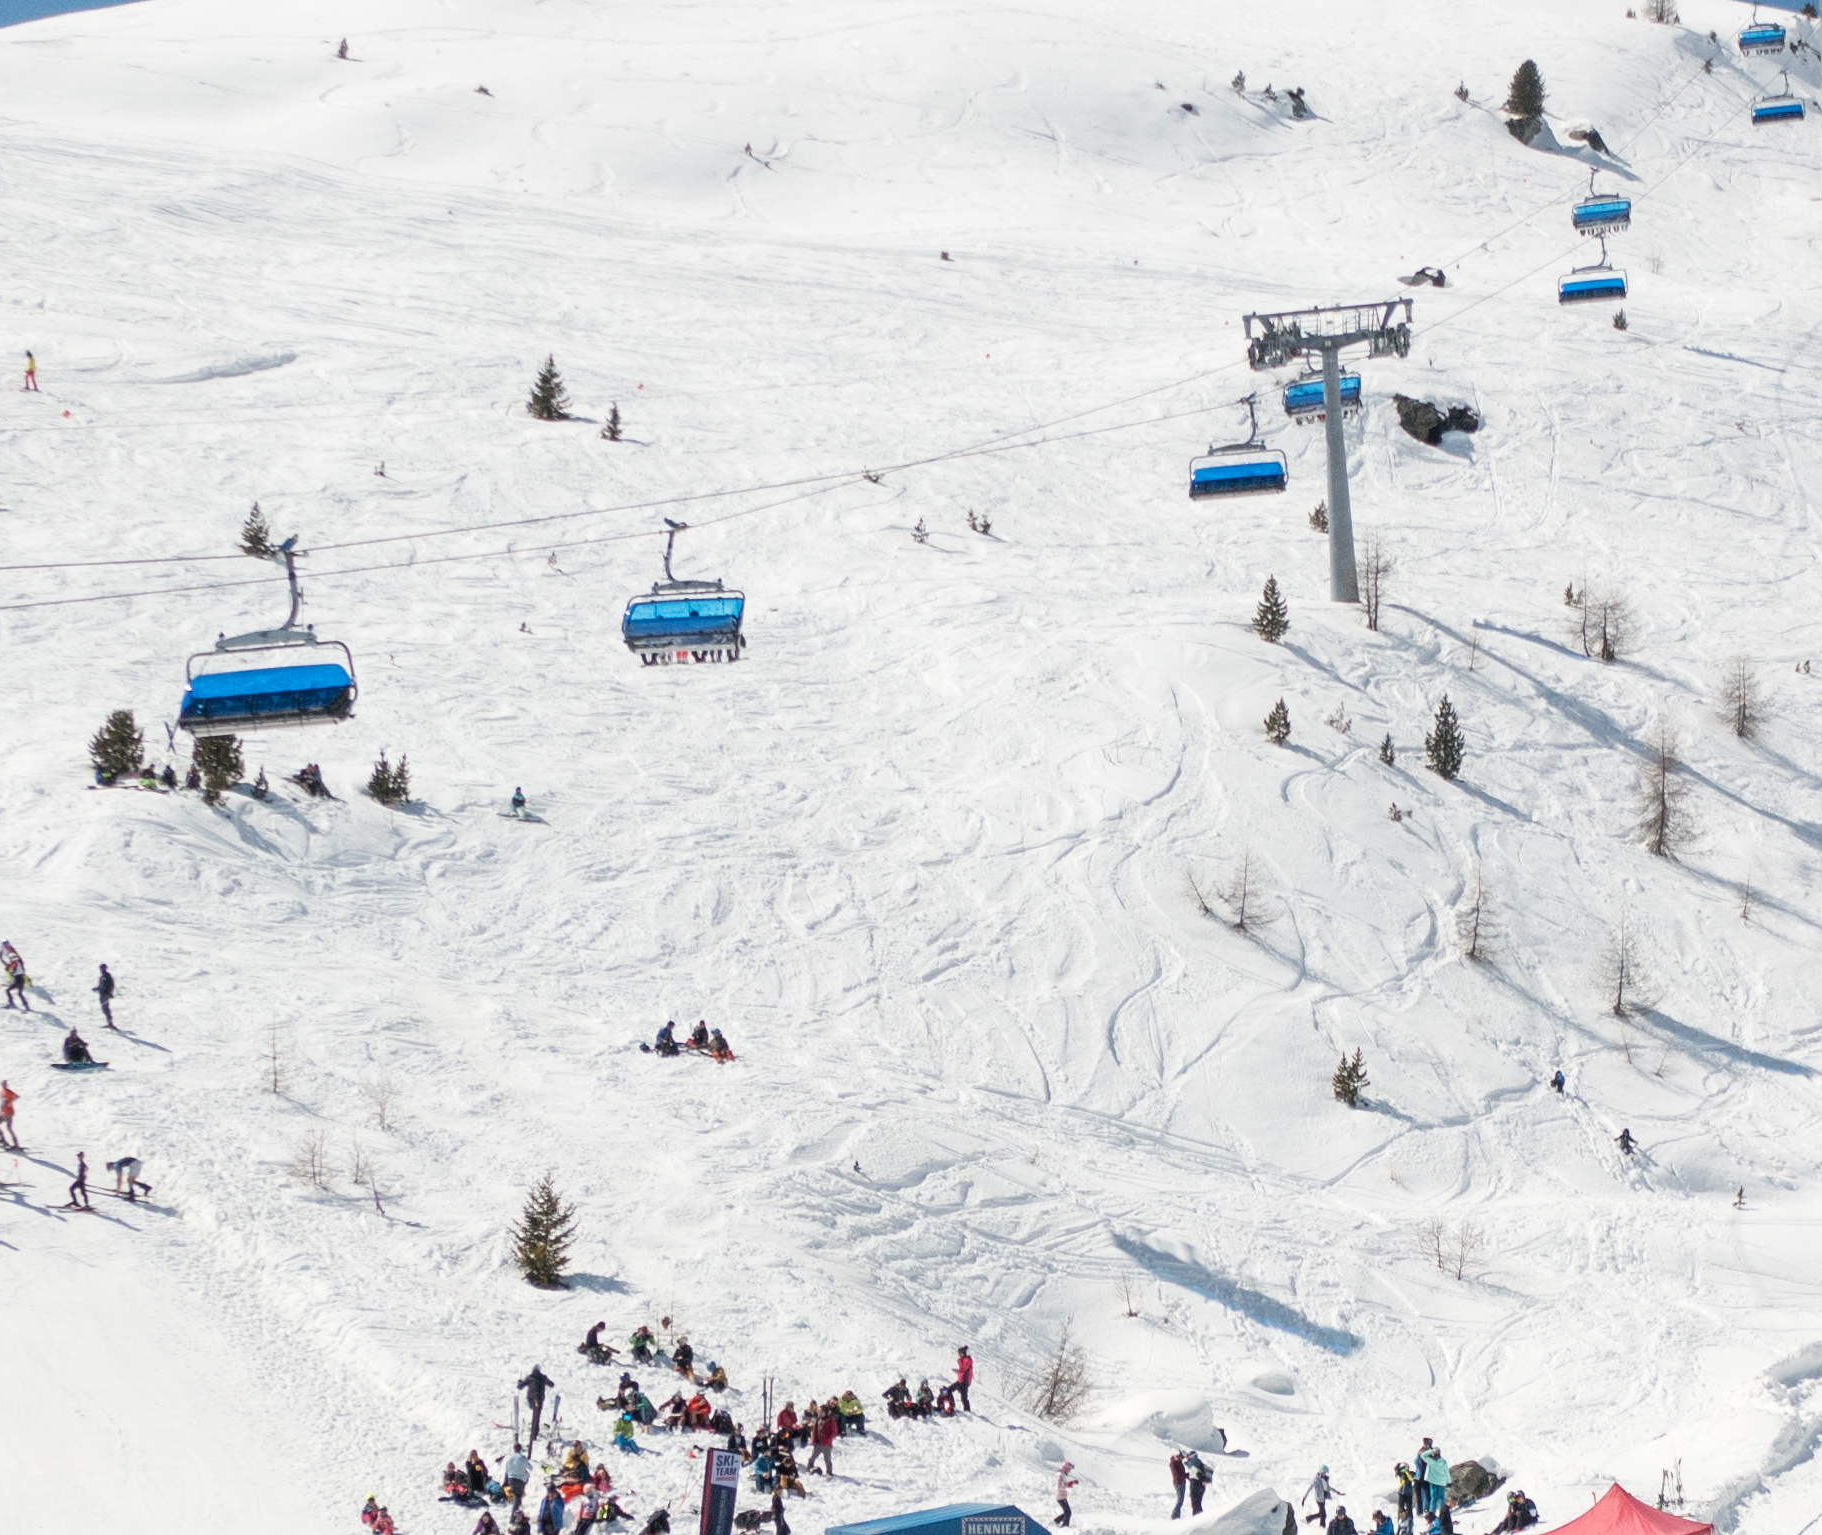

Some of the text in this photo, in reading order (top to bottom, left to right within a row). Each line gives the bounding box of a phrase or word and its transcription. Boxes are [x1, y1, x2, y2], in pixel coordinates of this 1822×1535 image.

[717, 1455, 739, 1467] SKI-
[716, 1468, 737, 1476] TEAM
[968, 1523, 1020, 1534] HENNIEZ
